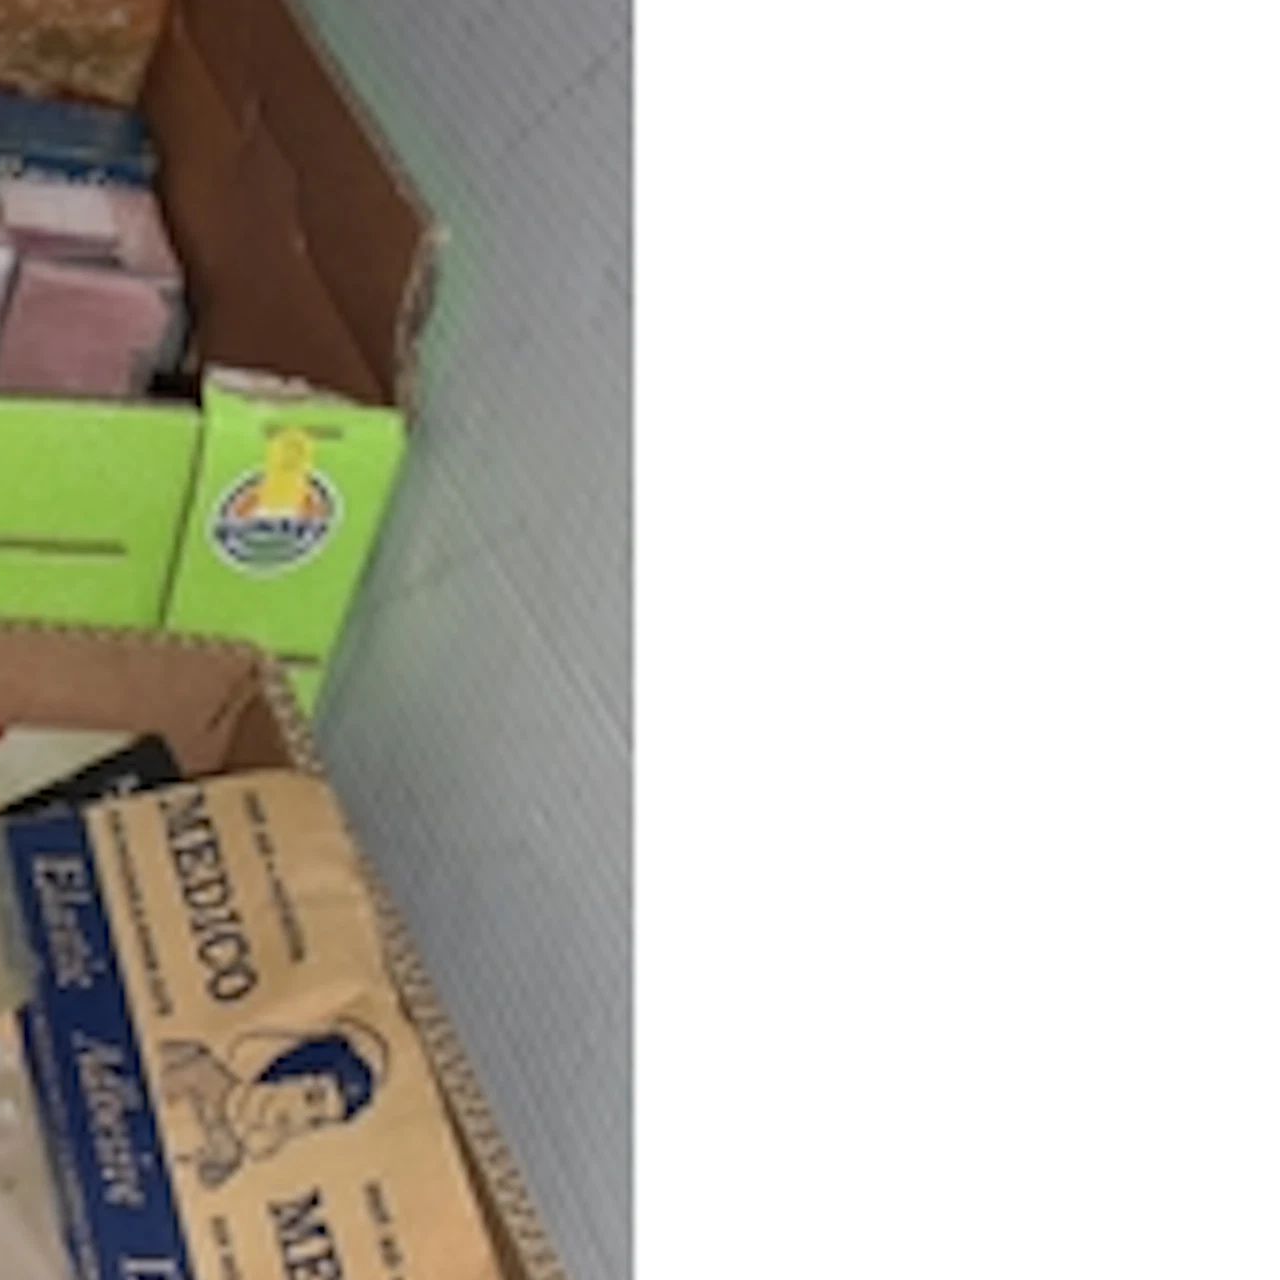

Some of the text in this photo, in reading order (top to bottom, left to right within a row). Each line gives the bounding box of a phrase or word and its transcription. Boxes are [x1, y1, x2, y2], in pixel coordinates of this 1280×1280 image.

[33, 853, 107, 990] Elastic
[72, 1029, 154, 1210] Adhesive
[159, 783, 258, 1004] MEDICO
